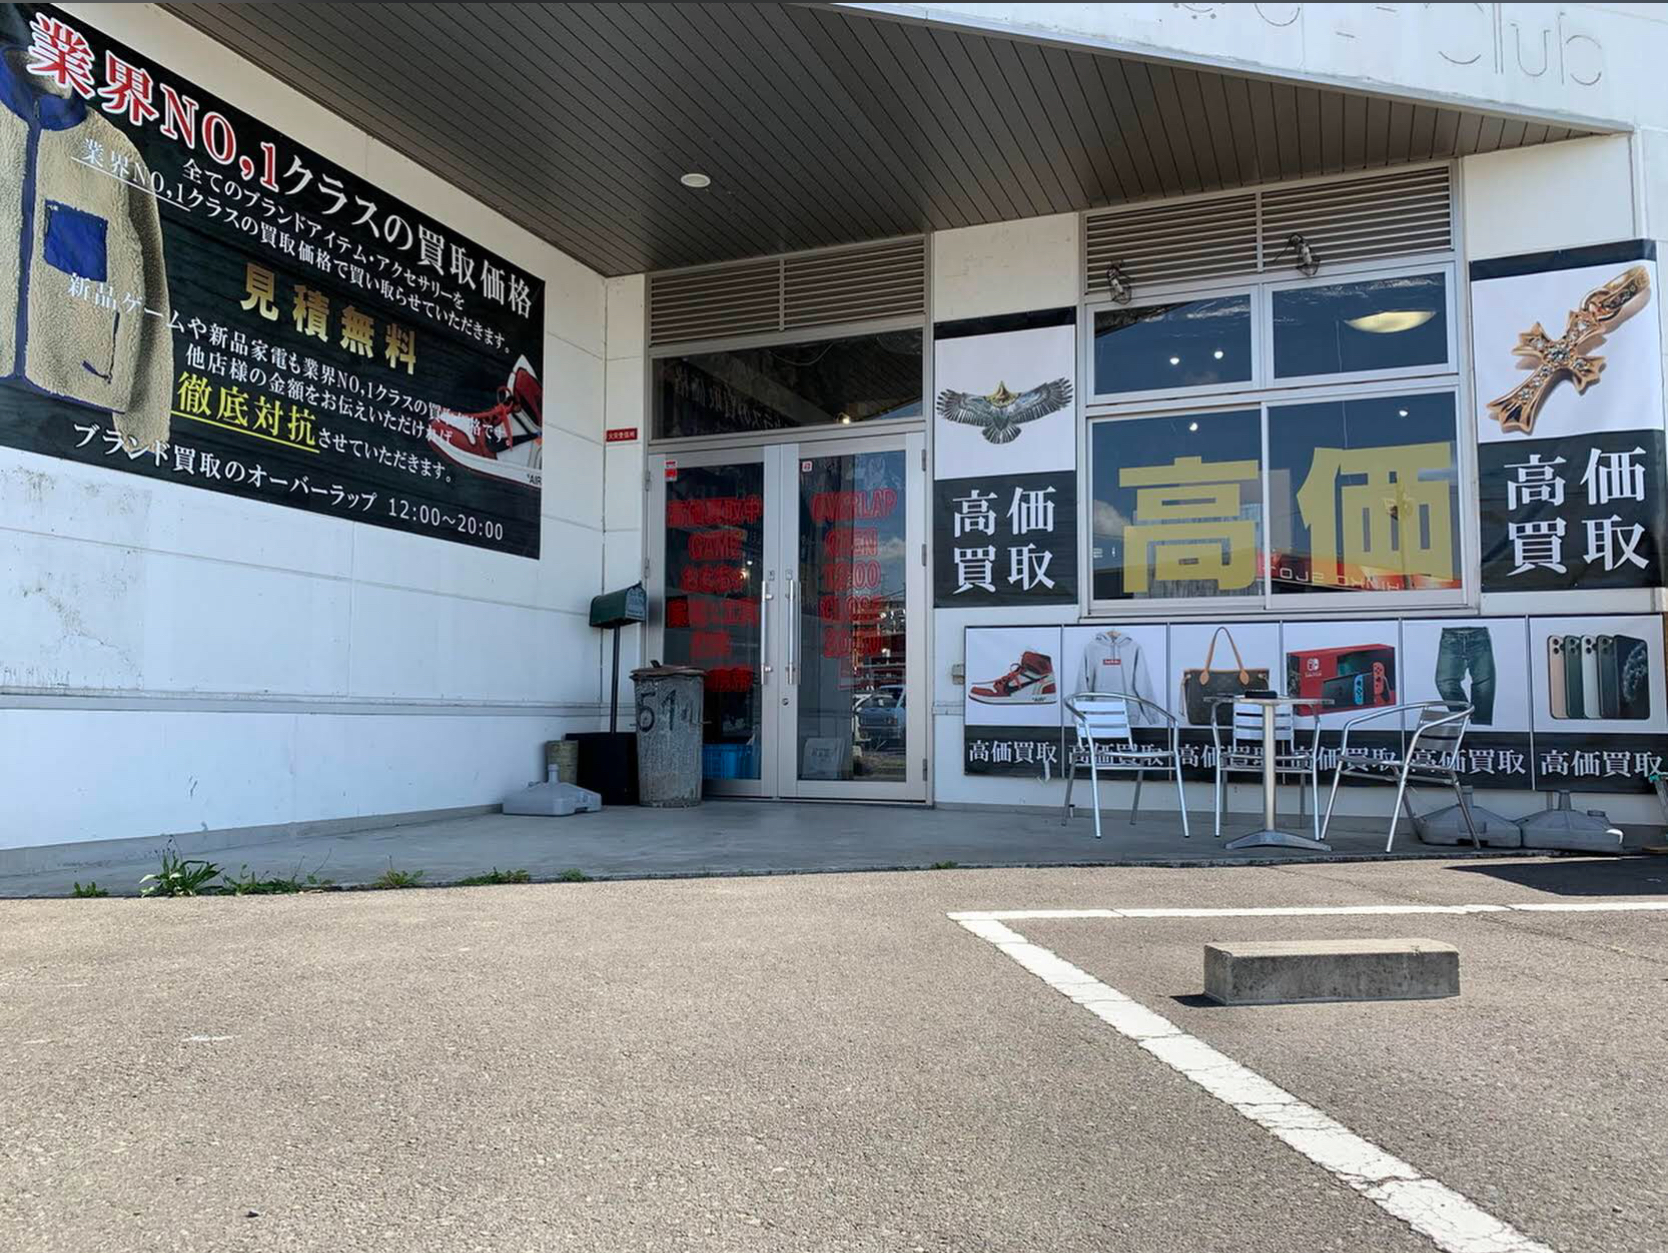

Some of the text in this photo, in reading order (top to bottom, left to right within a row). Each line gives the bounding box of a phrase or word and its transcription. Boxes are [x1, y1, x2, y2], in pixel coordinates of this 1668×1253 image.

[240, 263, 416, 375] 見積無料
[73, 422, 378, 512] ブランド買取のオーバーラップ
[1506, 447, 1648, 511] 高価
[952, 486, 1056, 538] 高価
[1119, 441, 1458, 594] 高価
[824, 527, 879, 557] OPEN
[1506, 514, 1651, 577] 買取
[952, 543, 1056, 594] 買取
[968, 740, 1058, 765] 高価買取
[1408, 748, 1526, 774] 高価買取
[1540, 749, 1663, 778] 高価買取
